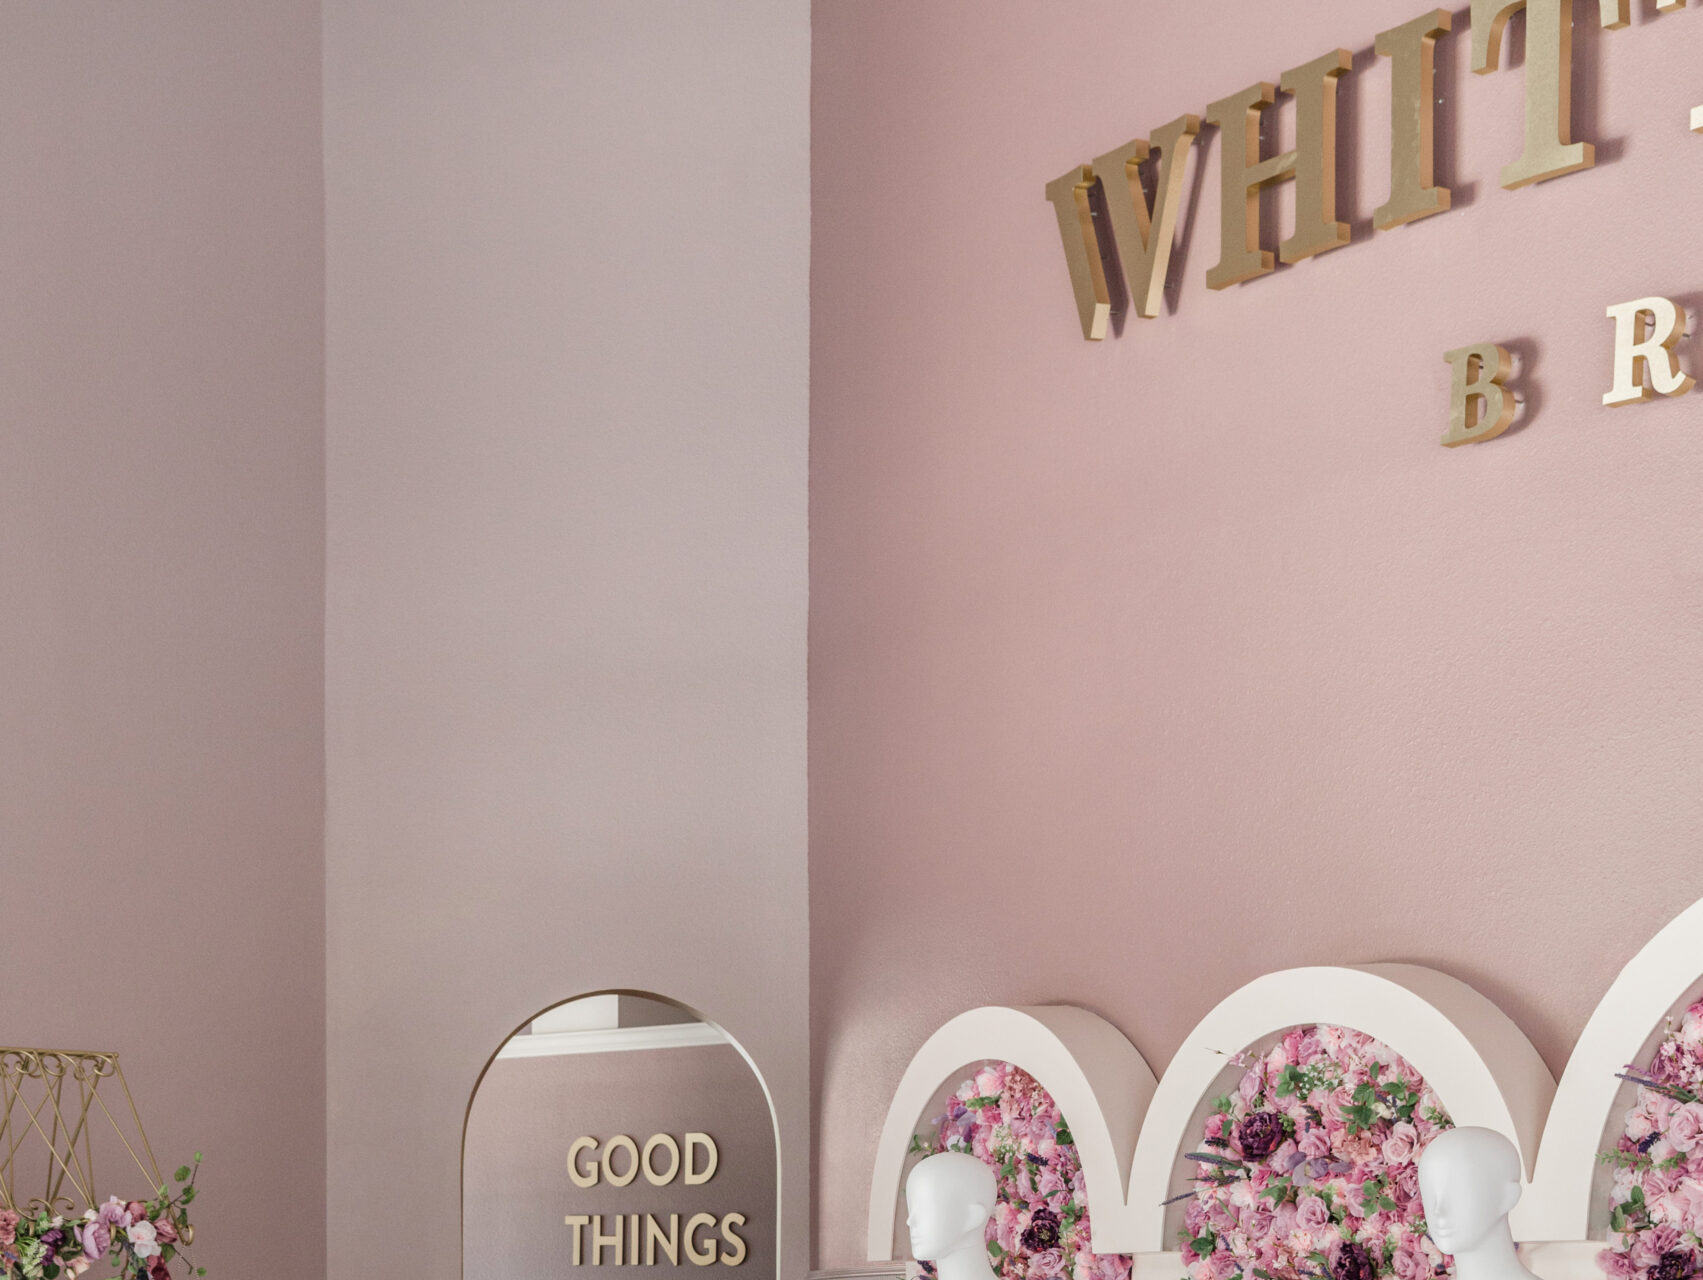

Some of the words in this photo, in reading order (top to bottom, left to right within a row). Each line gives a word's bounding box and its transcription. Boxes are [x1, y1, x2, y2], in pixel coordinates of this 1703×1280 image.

[1045, 0, 1703, 341] WHIT
[567, 1132, 719, 1188] GOOD
[564, 1212, 747, 1267] THINGS
